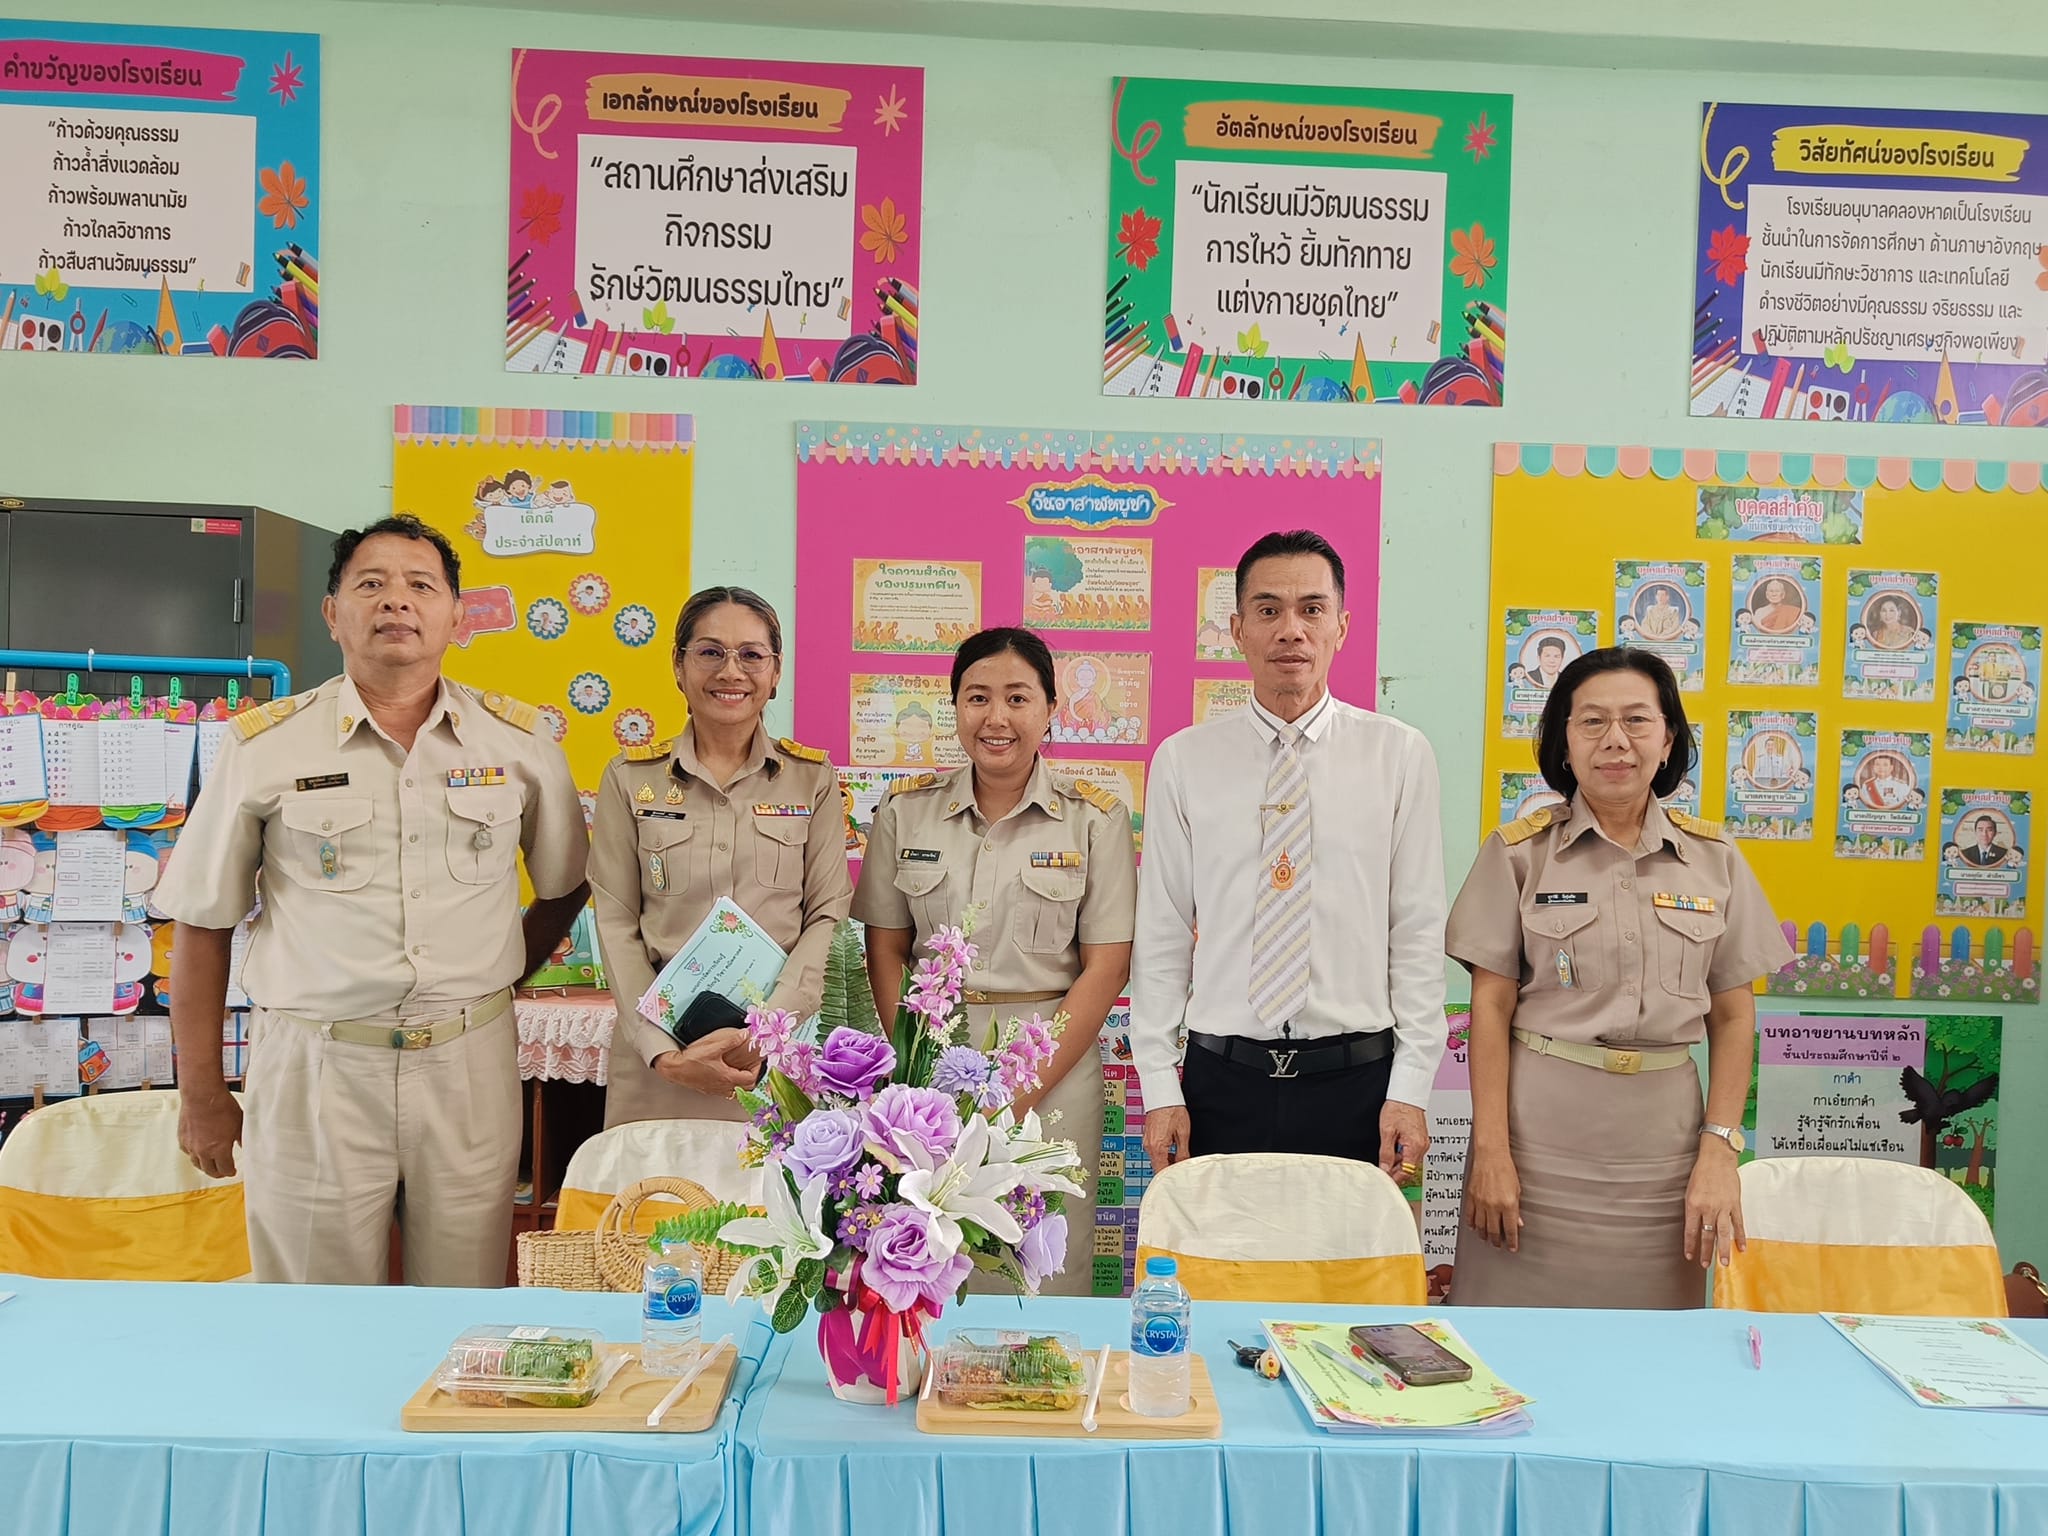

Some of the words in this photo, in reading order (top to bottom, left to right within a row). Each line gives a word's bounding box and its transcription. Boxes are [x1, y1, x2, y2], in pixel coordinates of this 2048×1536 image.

[4, 53, 202, 86] คำขวัญของโรงเรียน
[603, 87, 819, 119] เอกลักษณ์ของโรงเรียน
[1216, 113, 1418, 145] อัตลักษณ์ของโรงเรียน
[53, 147, 180, 175] ก้าวล้ำสิ่งแวดล้อม
[1800, 137, 1995, 169] วิสัยทัศน์ของโรงเรียน
[48, 184, 187, 208] ก้าวพร้อมพลานามัย
[1787, 196, 2032, 225] โรงเรียนอนุบาลคลองหาดเป็นโรงเรียน
[63, 217, 171, 240] ก้าวไกลวิชาการ
[665, 214, 772, 250] กิจกรรม
[1762, 224, 1925, 251] ชั้นนำในการจัดการศึกษา
[1930, 233, 2042, 260] ด้านภาษาอังกฤษ
[1206, 232, 1292, 265] การไหว้
[1300, 228, 1411, 269] ยิ้มทักทาย
[1761, 259, 1913, 284] นักเรียนมีทักษะวิชาการ
[1919, 264, 2009, 287] และเทคโนโลยี
[1759, 291, 1927, 319] ดำรงชีวิตอย่างมีคุณธรรม
[1932, 299, 1994, 318] จริยธรรม
[1999, 303, 2023, 318] และ
[1758, 324, 2019, 353] ปฏิบัติตามหลักปรัชญาเศรษฐกิจพอเพียง
[521, 510, 554, 524] เด็กดี
[1031, 491, 1150, 517] วันอาสาฬหบูชา
[1736, 495, 1823, 522] บุคคลสำคัญ
[495, 534, 582, 548] ประจำสัปดาห์
[879, 562, 957, 577] ใจความสำคัญ
[1764, 1024, 1920, 1041] บทอาขยานบทหลัก
[1783, 1044, 1889, 1062] ชั้นประถมศึกษาปีที่
[1892, 1054, 1901, 1062] ๒
[1833, 1072, 1862, 1084] กาดำ
[1813, 1093, 1875, 1107] กาเอ๋ยกาดำ
[1797, 1114, 1880, 1133] รู้จำรู้จักรักเพื่อน
[1146, 1329, 1177, 1340] CRYSTAL
